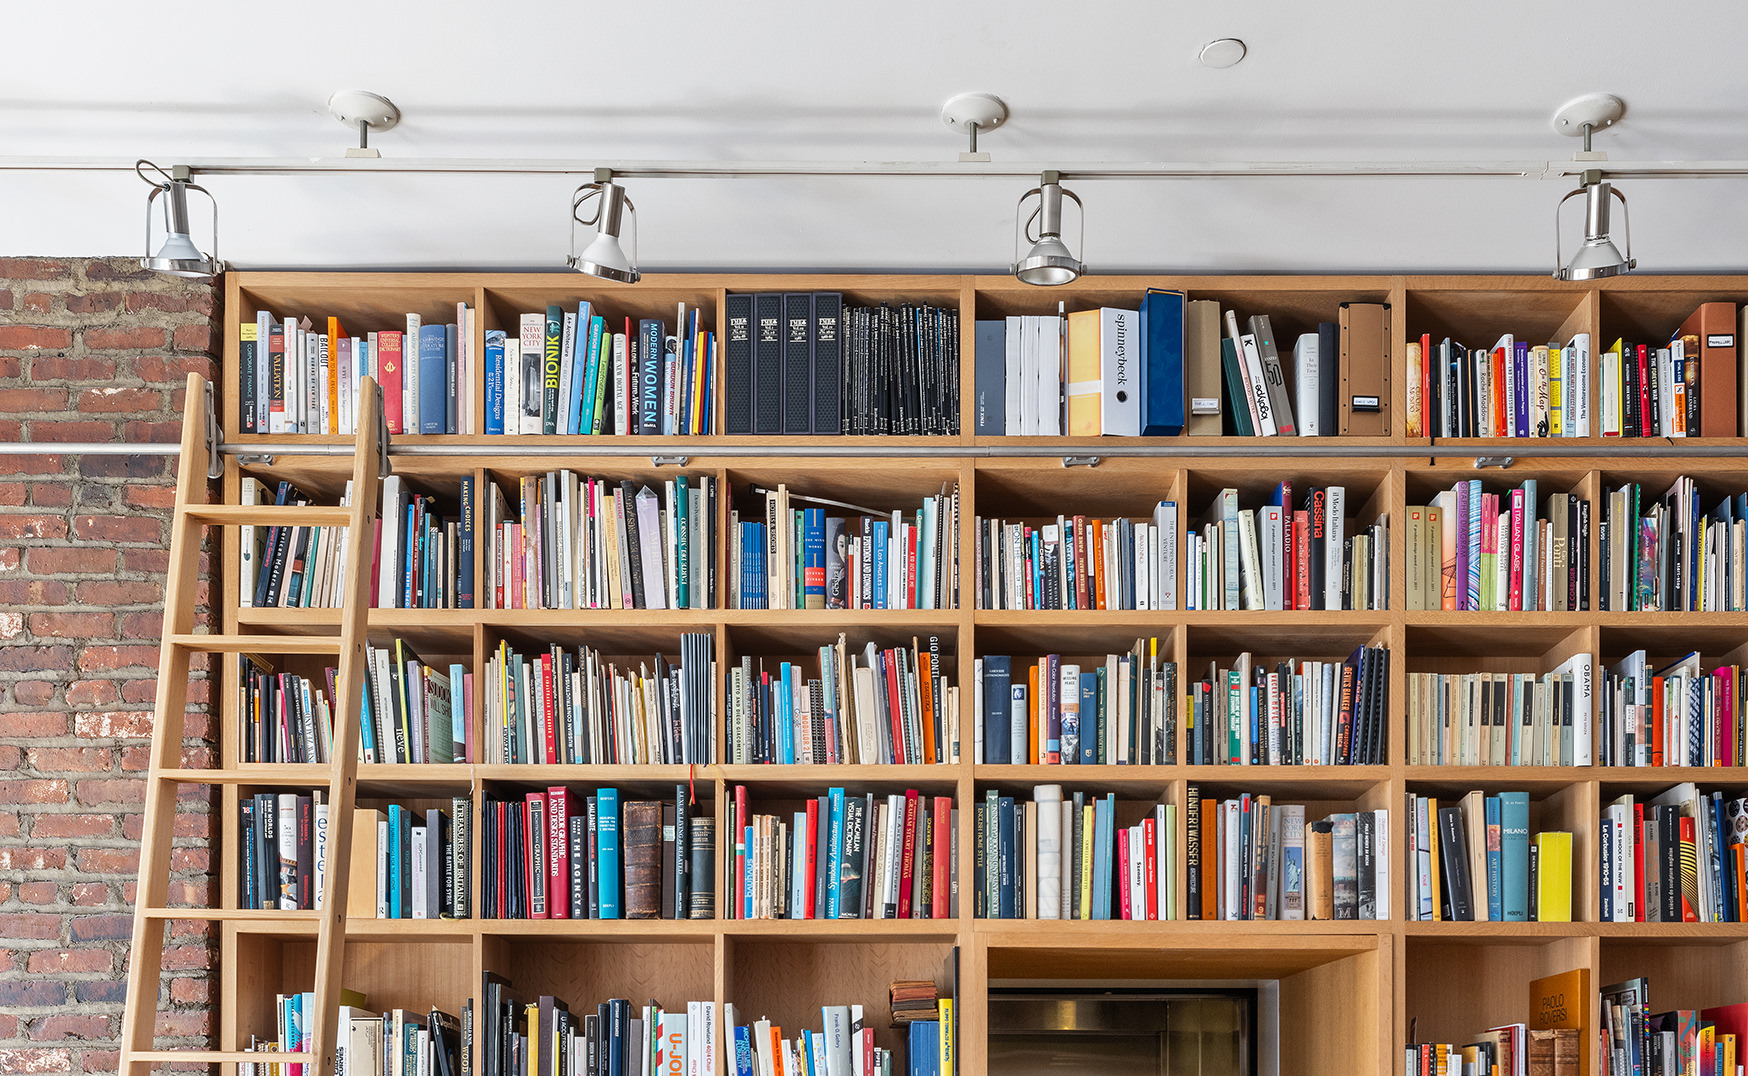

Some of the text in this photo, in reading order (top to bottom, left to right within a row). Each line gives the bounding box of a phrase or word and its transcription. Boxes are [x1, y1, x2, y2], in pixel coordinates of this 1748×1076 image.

[320, 337, 328, 368] BAILOUT
[546, 335, 560, 389] BIONIK
[1116, 314, 1128, 386] spinneybeck
[272, 354, 281, 399] VALUATION
[493, 354, 502, 420] Residential Designs
[644, 360, 657, 422] WOMEN
[1254, 384, 1268, 420] logotype
[1313, 491, 1324, 538] Cassina
[1460, 482, 1468, 558] GRAPHIS DIAGRAM
[270, 526, 288, 587] merican Modern
[1554, 536, 1566, 568] Ponti
[930, 636, 939, 678] GIO PONTI
[564, 673, 572, 723] CONSTRUCTIVISM
[1341, 667, 1352, 711] DEVIL'S BANKER
[396, 728, 405, 753] neve
[558, 798, 566, 858] INTERIOR GRAPHIC
[906, 798, 914, 827] GRAHAM
[1188, 788, 1199, 866] HUNDERTWASSER
[456, 806, 465, 901] TREASURES OF BRITAIN
[845, 821, 854, 856] DICTIONARY
[854, 820, 862, 852] MACMILLAN
[903, 852, 911, 879] THOMAS
[1540, 1008, 1567, 1024] ROVERSI
[1542, 992, 1565, 1010] PAOLO
